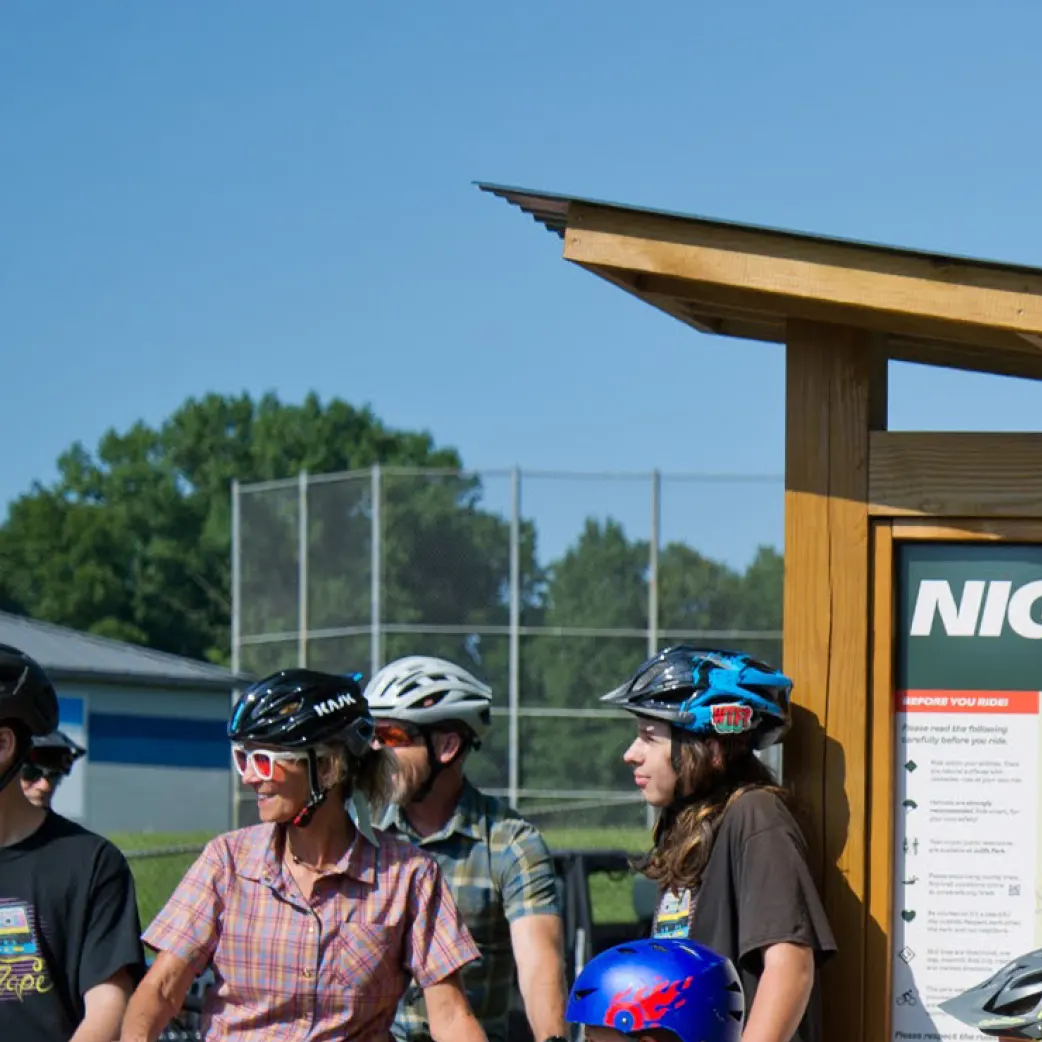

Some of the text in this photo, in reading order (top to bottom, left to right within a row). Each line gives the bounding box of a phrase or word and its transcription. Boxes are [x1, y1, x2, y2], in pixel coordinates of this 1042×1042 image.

[313, 693, 357, 717] KASK
[950, 697, 976, 706] YOU
[930, 725, 951, 733] read
[952, 724, 967, 733] the
[968, 725, 1008, 735] following
[941, 737, 969, 745] before
